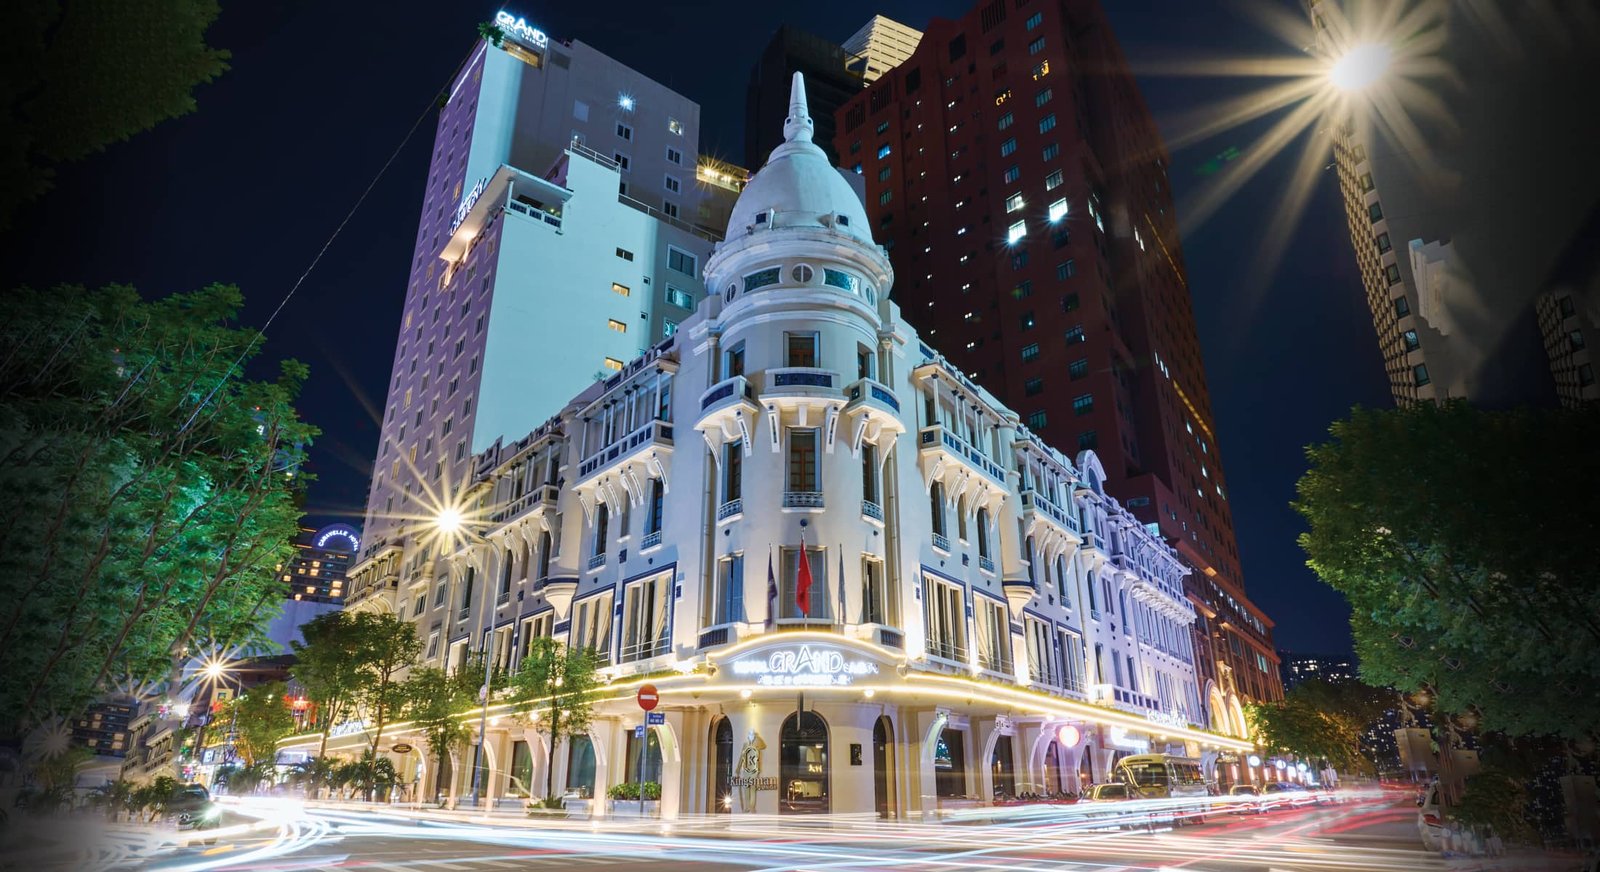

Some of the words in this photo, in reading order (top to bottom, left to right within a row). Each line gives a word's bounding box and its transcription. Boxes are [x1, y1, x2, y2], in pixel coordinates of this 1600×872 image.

[497, 11, 547, 43] GRAND
[769, 644, 844, 673] GRAND
[731, 776, 778, 788] Kingsman
